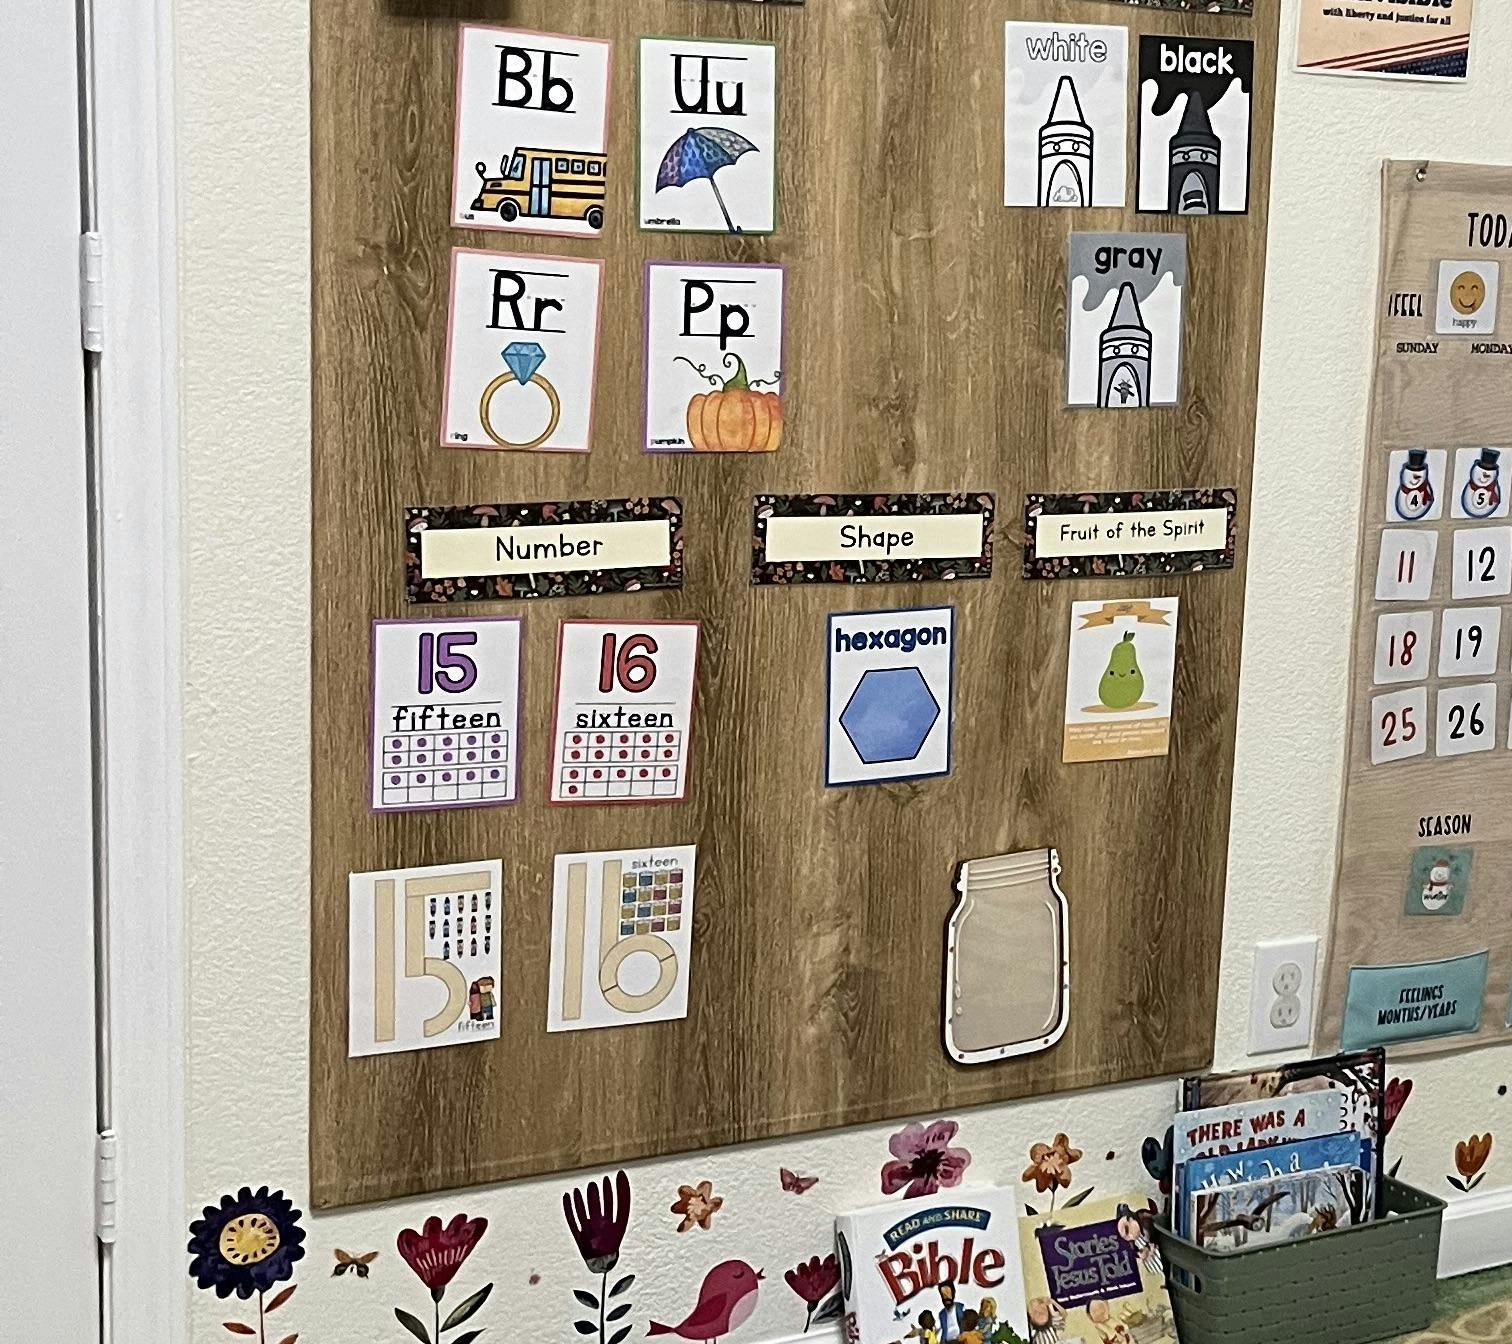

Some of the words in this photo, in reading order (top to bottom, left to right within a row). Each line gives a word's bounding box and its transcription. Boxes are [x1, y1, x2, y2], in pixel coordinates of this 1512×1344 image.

[1323, 8, 1343, 16] with
[1346, 8, 1375, 21] liberty
[1377, 12, 1393, 20] and
[1026, 31, 1107, 62] white
[1160, 44, 1234, 75] black
[498, 48, 573, 111] Bb
[675, 56, 744, 115] Uu
[1095, 245, 1163, 275] gray
[492, 271, 562, 330] Rr
[684, 281, 750, 350] Pp
[1397, 343, 1439, 353] SUNDAY
[1410, 493, 1419, 508] 4
[1476, 492, 1485, 506] 5
[840, 526, 914, 554] Shape
[1060, 524, 1101, 540] Fruit
[1107, 522, 1124, 537] of
[1130, 522, 1155, 537] the
[1164, 520, 1205, 538] Spirit
[496, 537, 603, 561] Number
[1398, 550, 1415, 583] 11
[1468, 546, 1496, 582] 12
[835, 625, 947, 653] hexagon
[1389, 630, 1416, 666] 18
[1455, 625, 1483, 660] 19
[418, 632, 477, 694] 15
[599, 633, 658, 693] 16
[392, 707, 502, 730] fifteen
[575, 710, 673, 728] sixteen
[1381, 706, 1416, 747] 25
[1448, 702, 1484, 738] 26
[1419, 814, 1472, 837] SEASON
[631, 856, 679, 869] sixteen
[1399, 985, 1444, 1004] FEELINGS
[1378, 1000, 1457, 1025] MONTHS/YEARS
[1187, 1119, 1243, 1146] THERE
[1250, 1110, 1285, 1134] WAS
[1294, 1109, 1305, 1127] A
[890, 1220, 920, 1242] READ
[1055, 1233, 1119, 1269] Stories
[878, 1238, 1005, 1305] Bible
[1052, 1265, 1098, 1294] Jesus
[1096, 1250, 1134, 1286] Told
